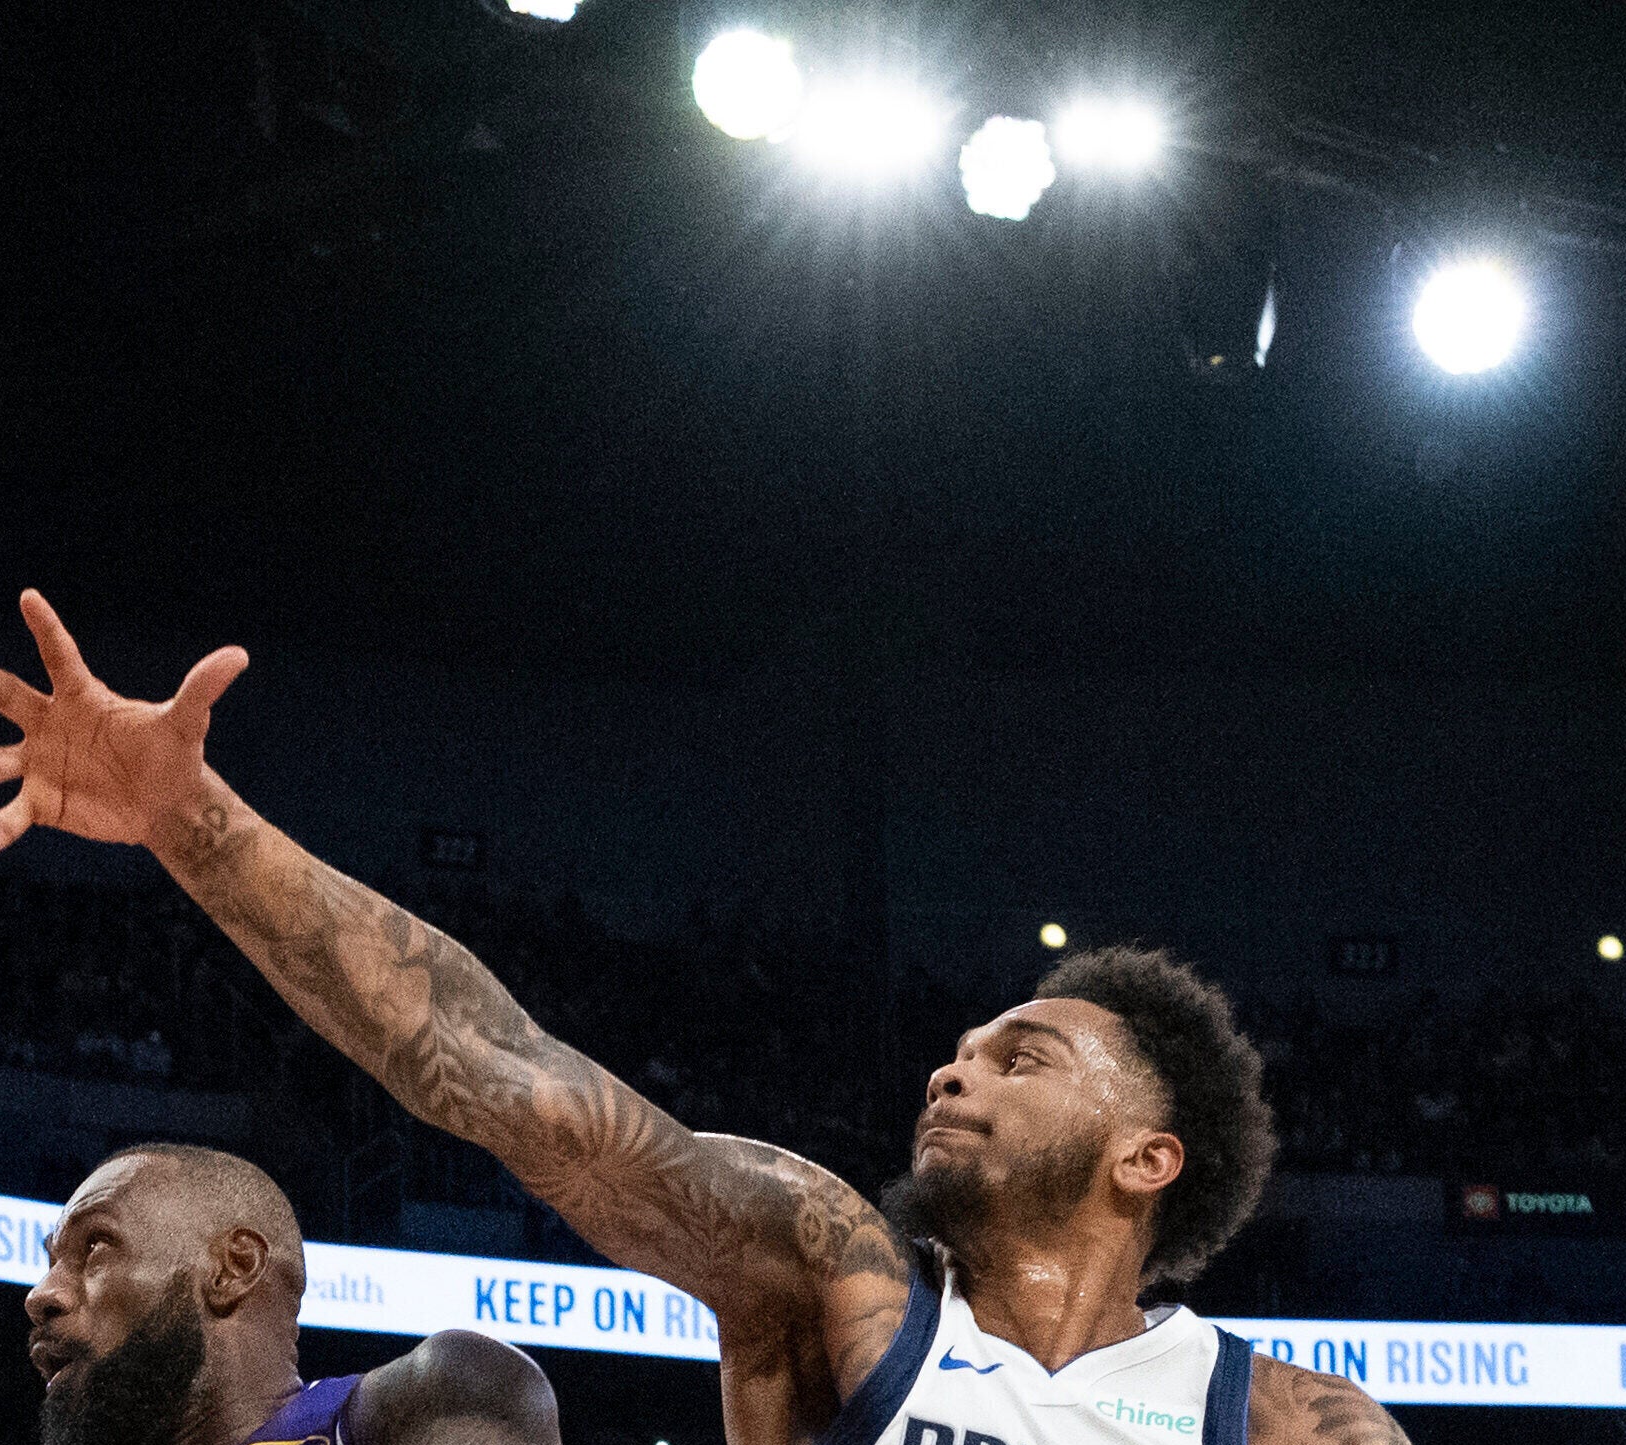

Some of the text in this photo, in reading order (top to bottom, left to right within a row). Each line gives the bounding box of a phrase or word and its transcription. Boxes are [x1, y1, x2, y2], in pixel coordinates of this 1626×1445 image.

[1506, 1192, 1594, 1217] TOYOTA
[304, 1274, 385, 1304] ealth
[475, 1277, 576, 1329] KEEP
[592, 1286, 648, 1336] ON
[1314, 1339, 1367, 1384] ON
[1387, 1340, 1529, 1387] RISING
[1095, 1398, 1196, 1435] chime
